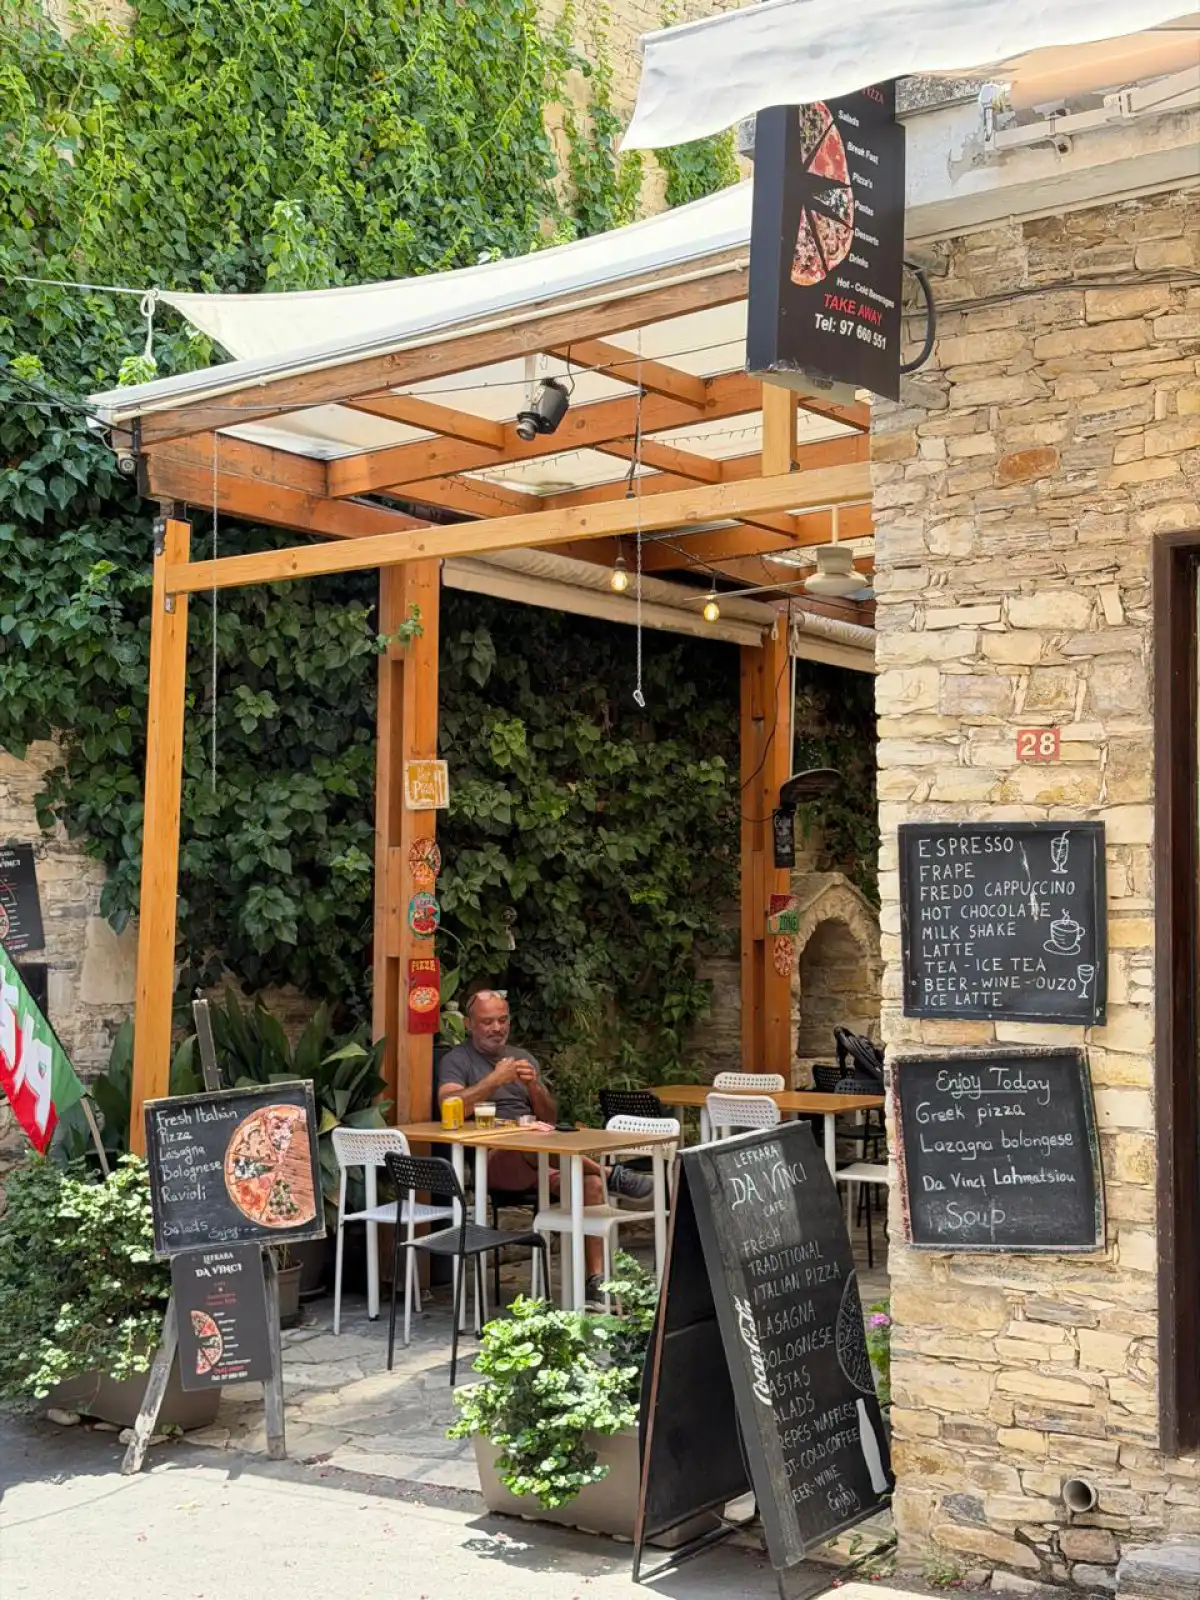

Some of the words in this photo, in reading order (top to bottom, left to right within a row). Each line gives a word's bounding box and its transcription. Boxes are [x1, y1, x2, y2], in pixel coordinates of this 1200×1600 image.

[836, 277, 850, 289] Hot
[824, 293, 857, 316] TAKE
[857, 304, 882, 327] AWAY
[814, 313, 837, 333] Tel:
[840, 319, 855, 336] 97
[856, 324, 872, 344] 660
[872, 332, 887, 351] 551
[1020, 732, 1056, 756] 28
[918, 836, 1014, 858] ESPRESSO
[919, 862, 976, 882] FRAPE
[920, 883, 974, 901] FREDO
[984, 880, 1076, 897] CAPPUCCINO
[921, 905, 953, 921] HOT
[960, 902, 1051, 920] CHOCOLATE
[921, 925, 960, 941] MILK
[969, 922, 1017, 940] SHAKE
[923, 942, 975, 959] LATTE
[924, 960, 957, 975] TEA
[976, 958, 1004, 972] ICE
[1010, 958, 1046, 972] TEA
[924, 994, 947, 1007] ICE
[955, 992, 1003, 1007] LATTE
[936, 1069, 982, 1099] Enjoy
[989, 1067, 1051, 1106] Today
[156, 1109, 192, 1128] Fresh
[195, 1104, 238, 1123] Italian
[915, 1101, 966, 1124] Greek
[977, 1103, 1026, 1128] pizza
[157, 1128, 194, 1145] Pizza
[919, 1133, 994, 1160] Lazagna
[1000, 1129, 1074, 1156] bolongese
[161, 1160, 222, 1183] Bolognese
[922, 1174, 947, 1192] Da
[950, 1172, 988, 1194] Vinci
[161, 1185, 207, 1203] Ravioli
[729, 1172, 765, 1211] DA
[762, 1161, 807, 1194] VINCI
[946, 1201, 1006, 1242] Soup
[742, 1228, 782, 1258] FRESH
[195, 1267, 212, 1278] DA
[212, 1263, 242, 1275] VINCI
[748, 1240, 824, 1277] TRADITIONAL
[753, 1275, 801, 1305] ITALIAN
[805, 1261, 842, 1287] PIZZA
[757, 1299, 816, 1341] LASAGNA
[768, 1364, 811, 1400] ASTAS
[773, 1390, 815, 1423] ALADS
